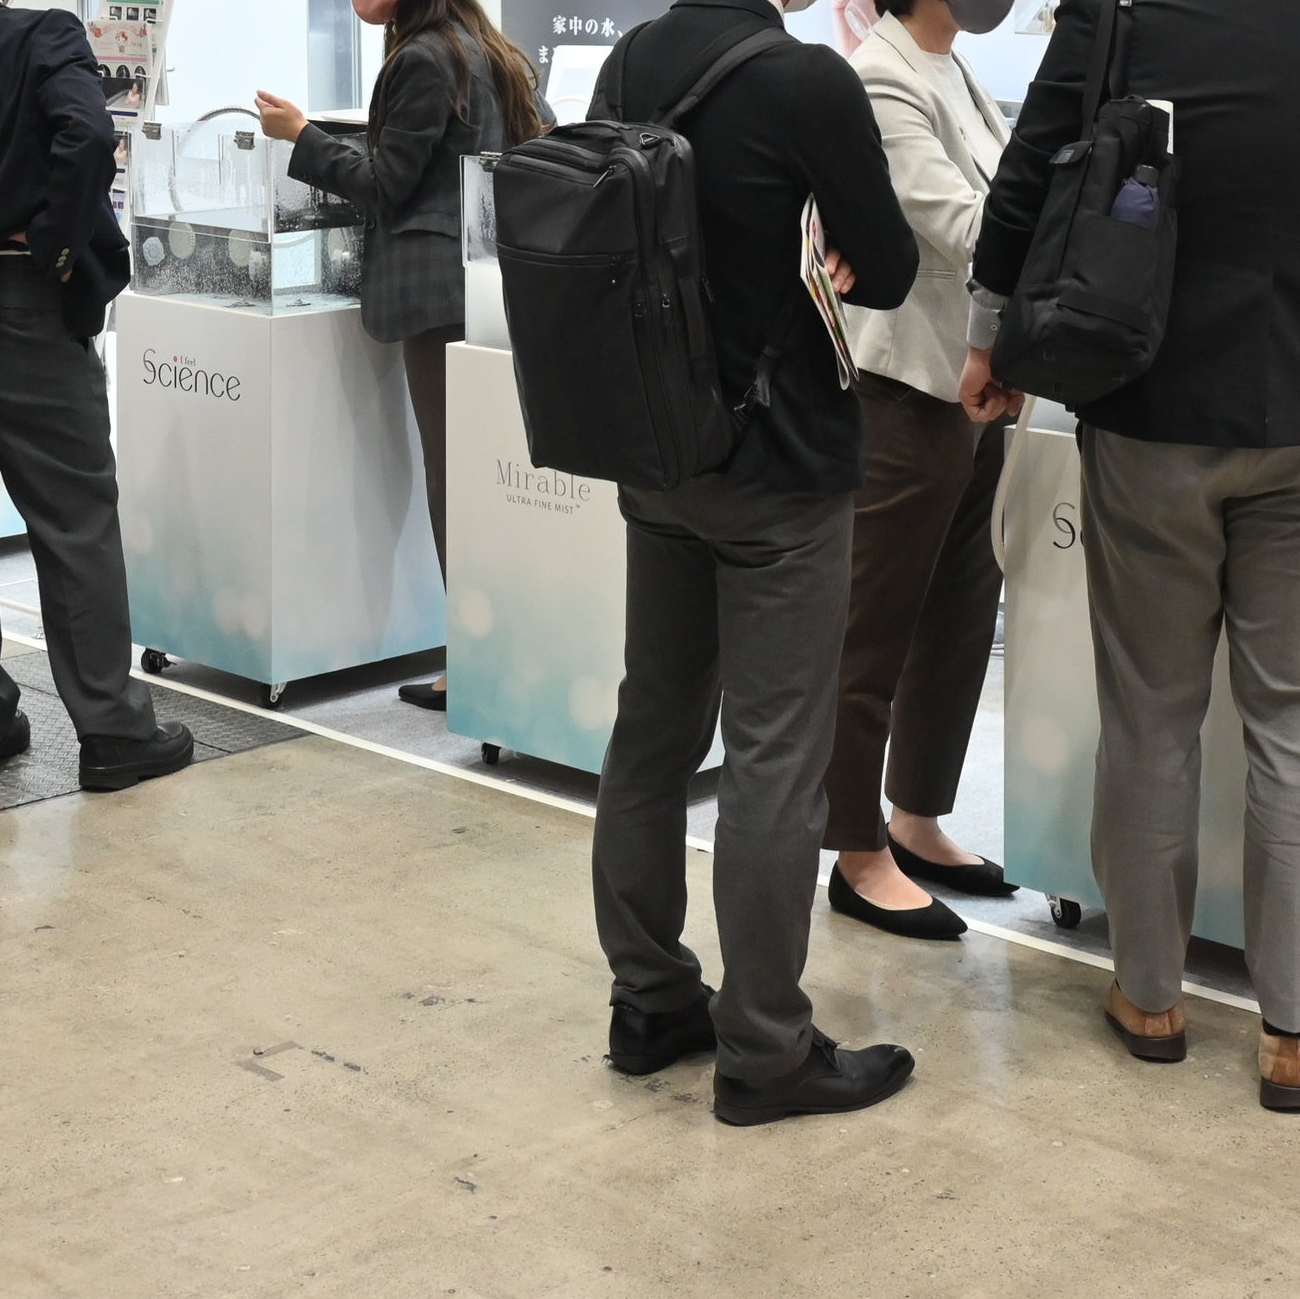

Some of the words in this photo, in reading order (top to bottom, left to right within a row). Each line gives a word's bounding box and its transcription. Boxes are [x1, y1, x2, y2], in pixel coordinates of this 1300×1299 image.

[552, 14, 624, 38] 家中の水、
[142, 348, 241, 402] Science
[496, 459, 592, 502] Mirable
[506, 493, 532, 507] ULTRA
[534, 499, 553, 511] FINE
